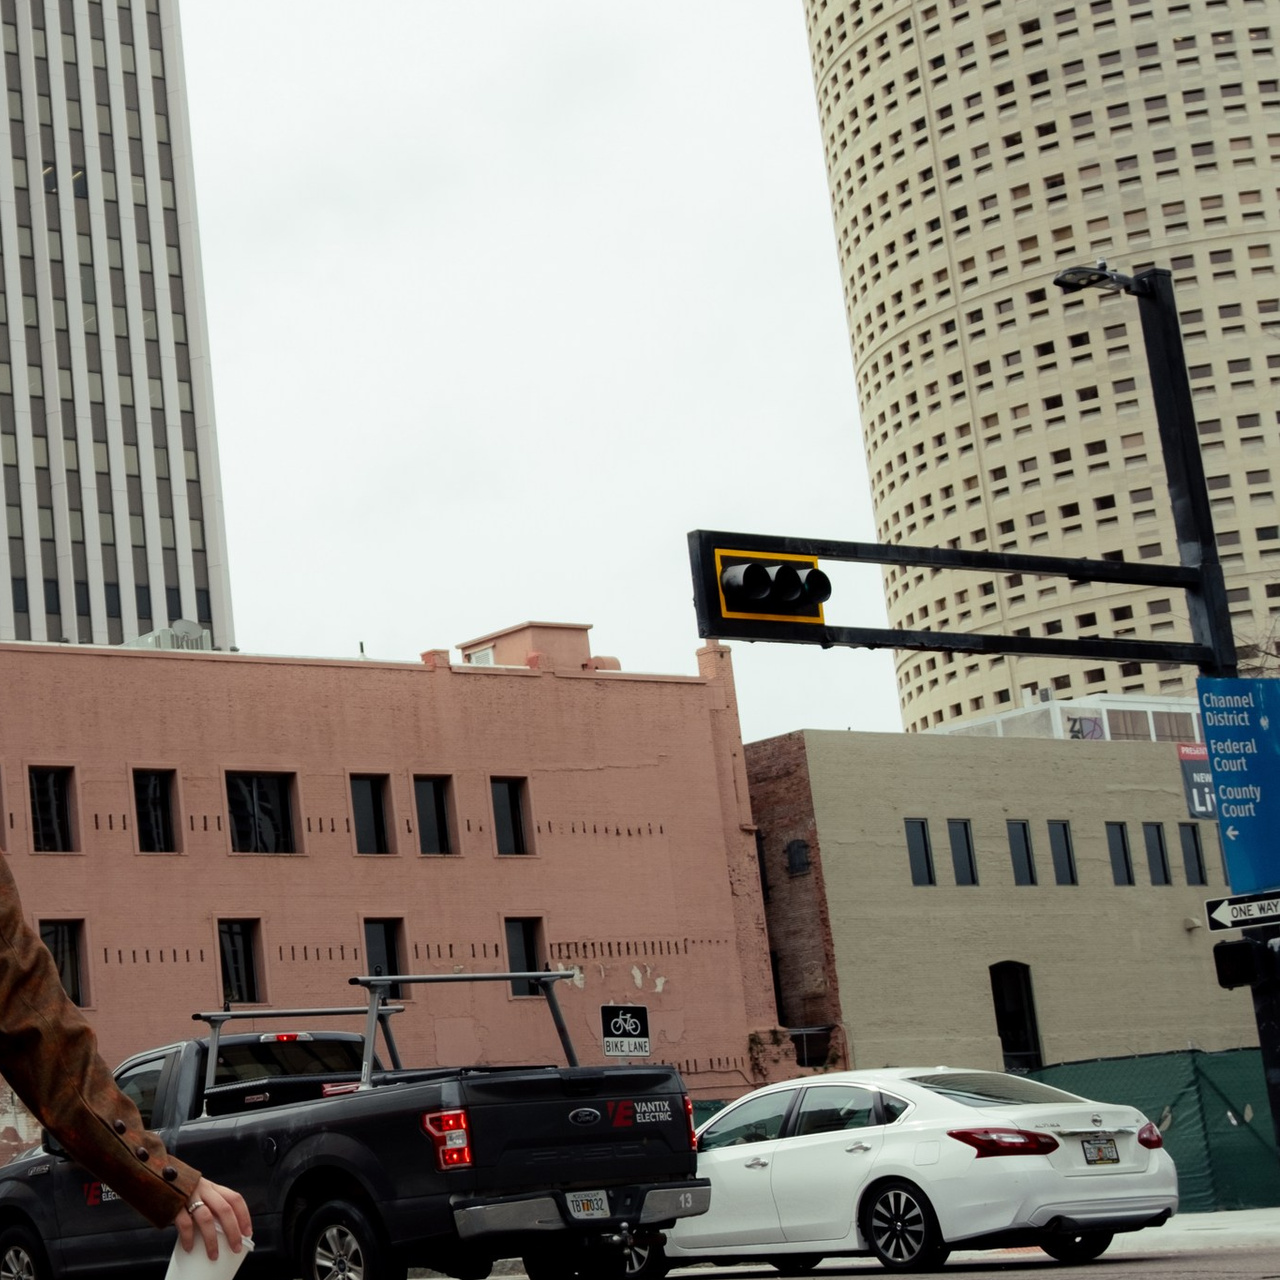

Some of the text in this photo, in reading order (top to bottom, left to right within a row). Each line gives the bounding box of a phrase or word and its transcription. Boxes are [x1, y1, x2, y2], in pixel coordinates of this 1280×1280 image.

[1202, 692, 1255, 708] Channel
[1206, 711, 1251, 726] District
[1210, 738, 1258, 754] Federal
[1214, 757, 1248, 772] Court
[1219, 784, 1262, 803] County
[1222, 802, 1256, 818] Court
[1231, 900, 1280, 919] ONE WAY
[605, 1040, 649, 1053] BIKE LANE
[634, 1100, 671, 1113] VANTIX
[636, 1111, 673, 1123] ELECTRIC
[679, 1192, 693, 1208] 13
